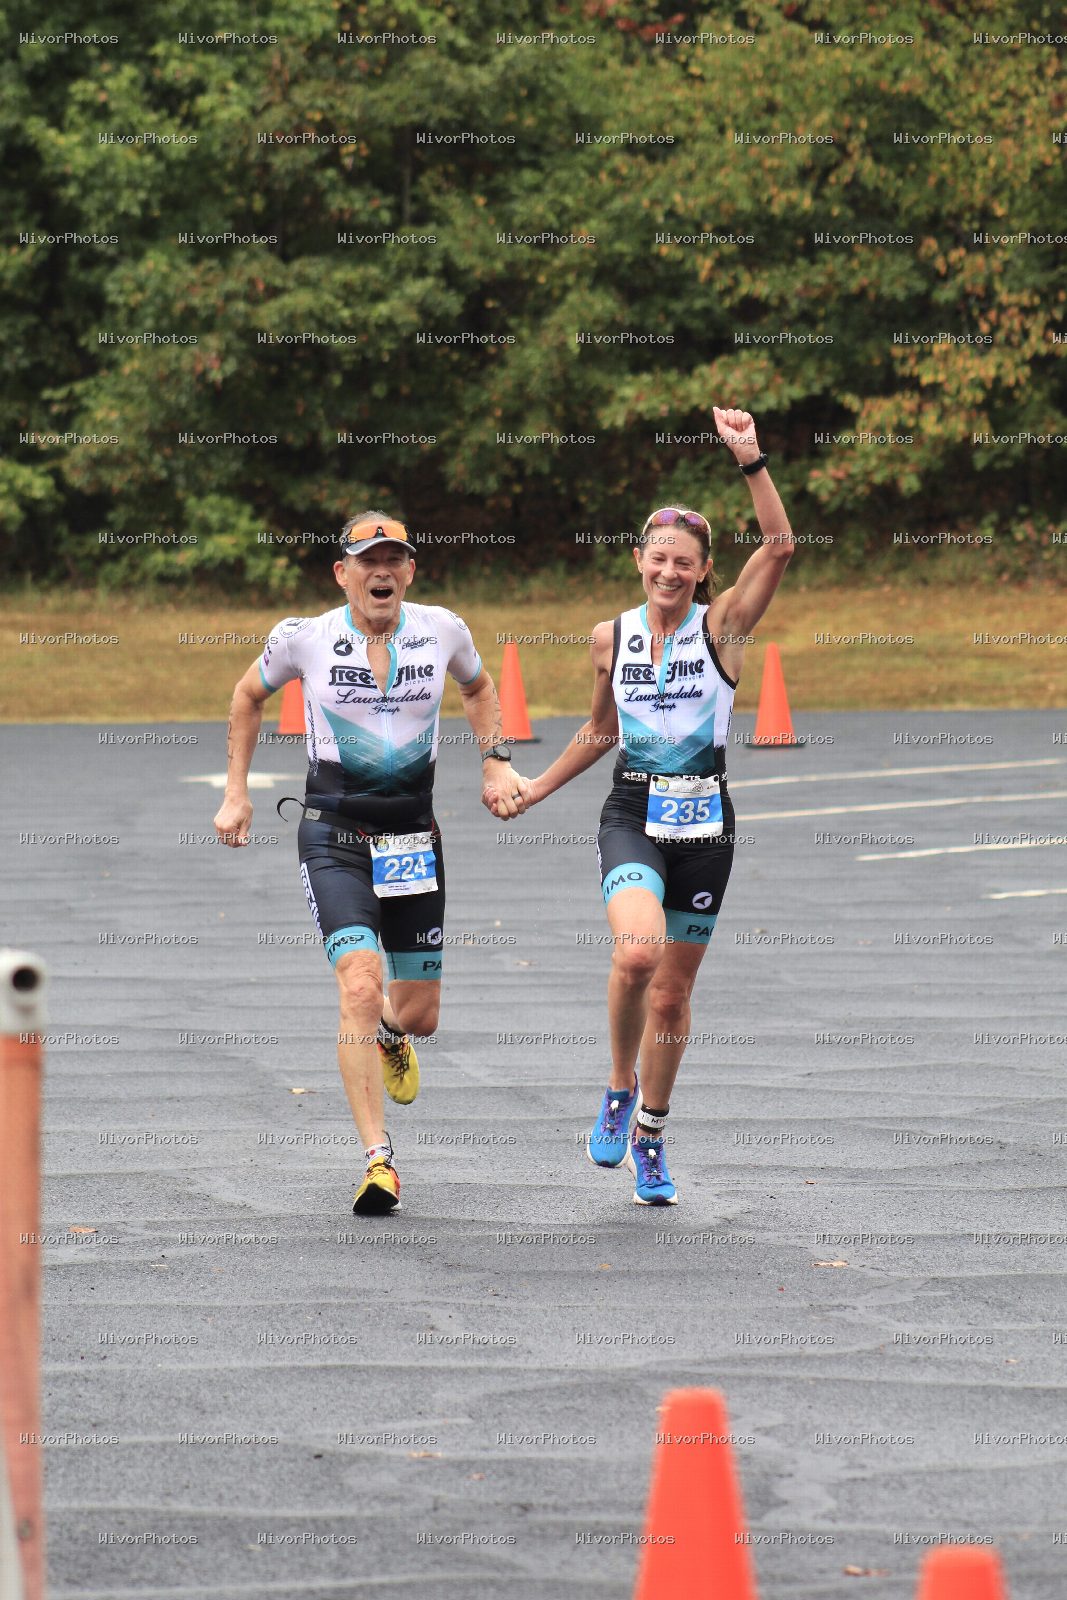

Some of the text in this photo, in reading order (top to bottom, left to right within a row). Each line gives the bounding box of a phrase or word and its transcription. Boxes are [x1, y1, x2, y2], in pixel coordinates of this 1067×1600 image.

[630, 771, 648, 779] PTS
[660, 798, 711, 824] 235
[384, 853, 428, 881] 224
[603, 871, 644, 903] IMO
